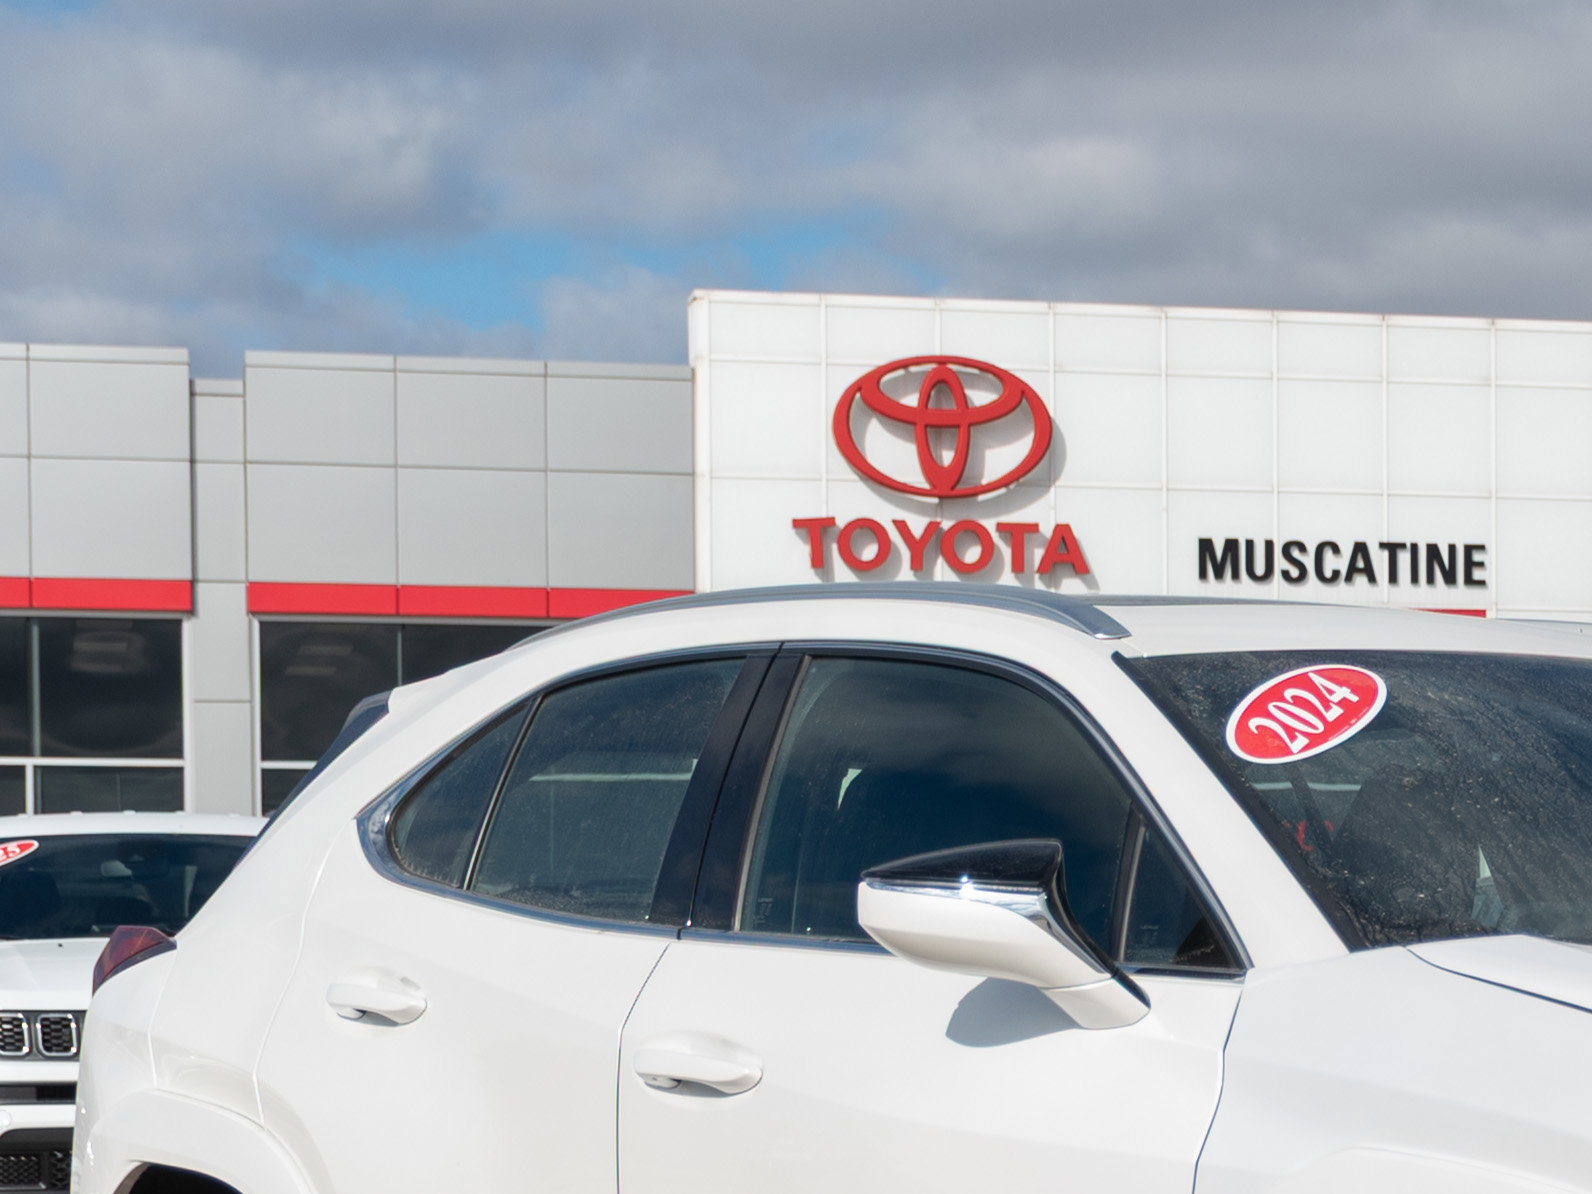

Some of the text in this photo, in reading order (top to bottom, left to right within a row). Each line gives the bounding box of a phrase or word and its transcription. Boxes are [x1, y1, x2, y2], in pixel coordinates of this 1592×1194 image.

[792, 517, 1090, 574] TOYOTA
[1198, 538, 1487, 585] MUSCATINE
[1248, 672, 1359, 754] 2024
